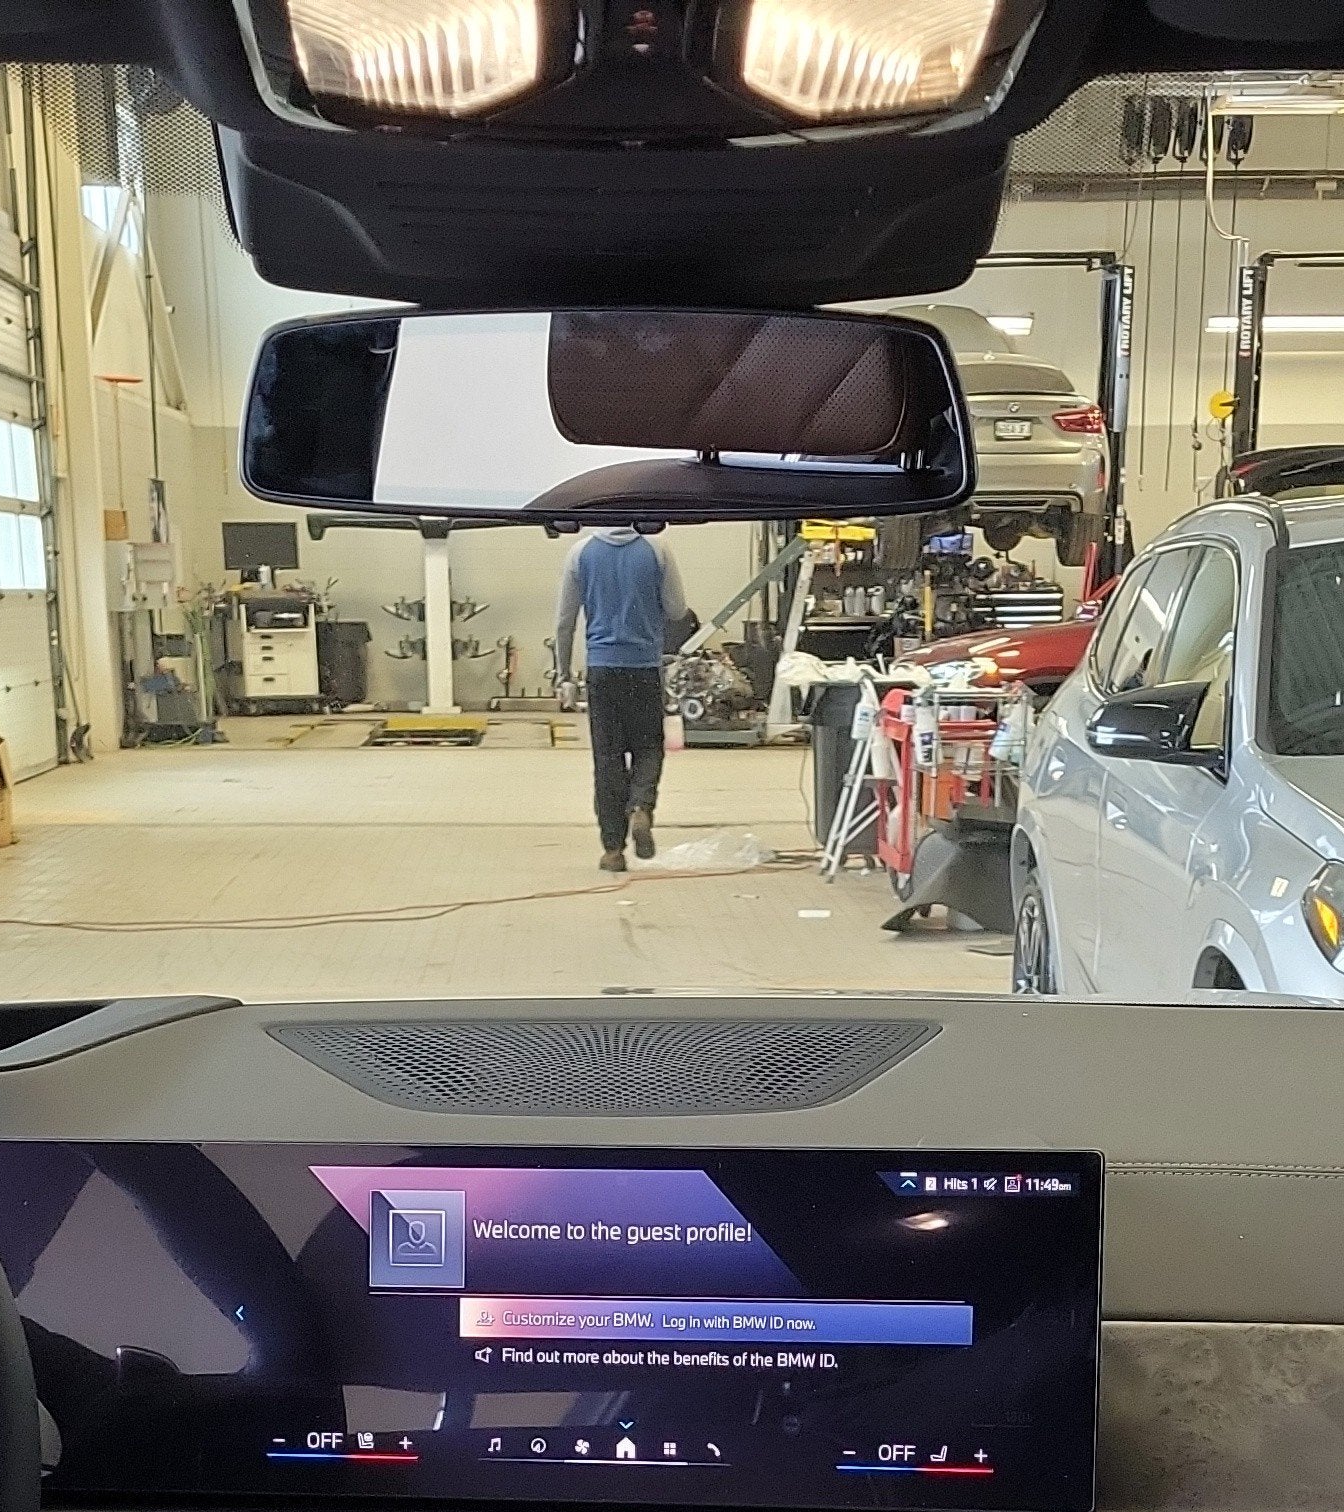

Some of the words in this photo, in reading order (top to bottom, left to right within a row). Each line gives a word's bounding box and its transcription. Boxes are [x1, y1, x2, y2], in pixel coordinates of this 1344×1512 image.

[1122, 267, 1134, 295] LIFT
[1242, 268, 1255, 295] LIFT
[1121, 297, 1132, 349] ROTARY
[1239, 298, 1253, 350] ROTARY
[473, 1220, 560, 1240] Welcome
[566, 1223, 585, 1240] to
[591, 1222, 621, 1241] the
[627, 1223, 681, 1245] guest
[686, 1222, 753, 1245] profile!
[502, 1311, 575, 1327] Customize
[578, 1313, 611, 1329] your
[613, 1312, 655, 1329] BMW.
[662, 1315, 686, 1331] Log
[689, 1315, 701, 1329] in
[703, 1315, 730, 1329] with
[732, 1316, 767, 1330] BMW
[769, 1316, 783, 1330] ID
[787, 1319, 816, 1330] now.
[502, 1347, 533, 1363] Find
[536, 1349, 560, 1364] out
[563, 1352, 599, 1365] more
[603, 1350, 644, 1365] about
[647, 1351, 670, 1365] the
[673, 1350, 729, 1367] benefits
[733, 1351, 748, 1366] of
[750, 1351, 774, 1367] the
[776, 1352, 816, 1368] BMW
[819, 1353, 838, 1368] ID.
[307, 1431, 344, 1449] OFF
[878, 1444, 916, 1461] OFF
